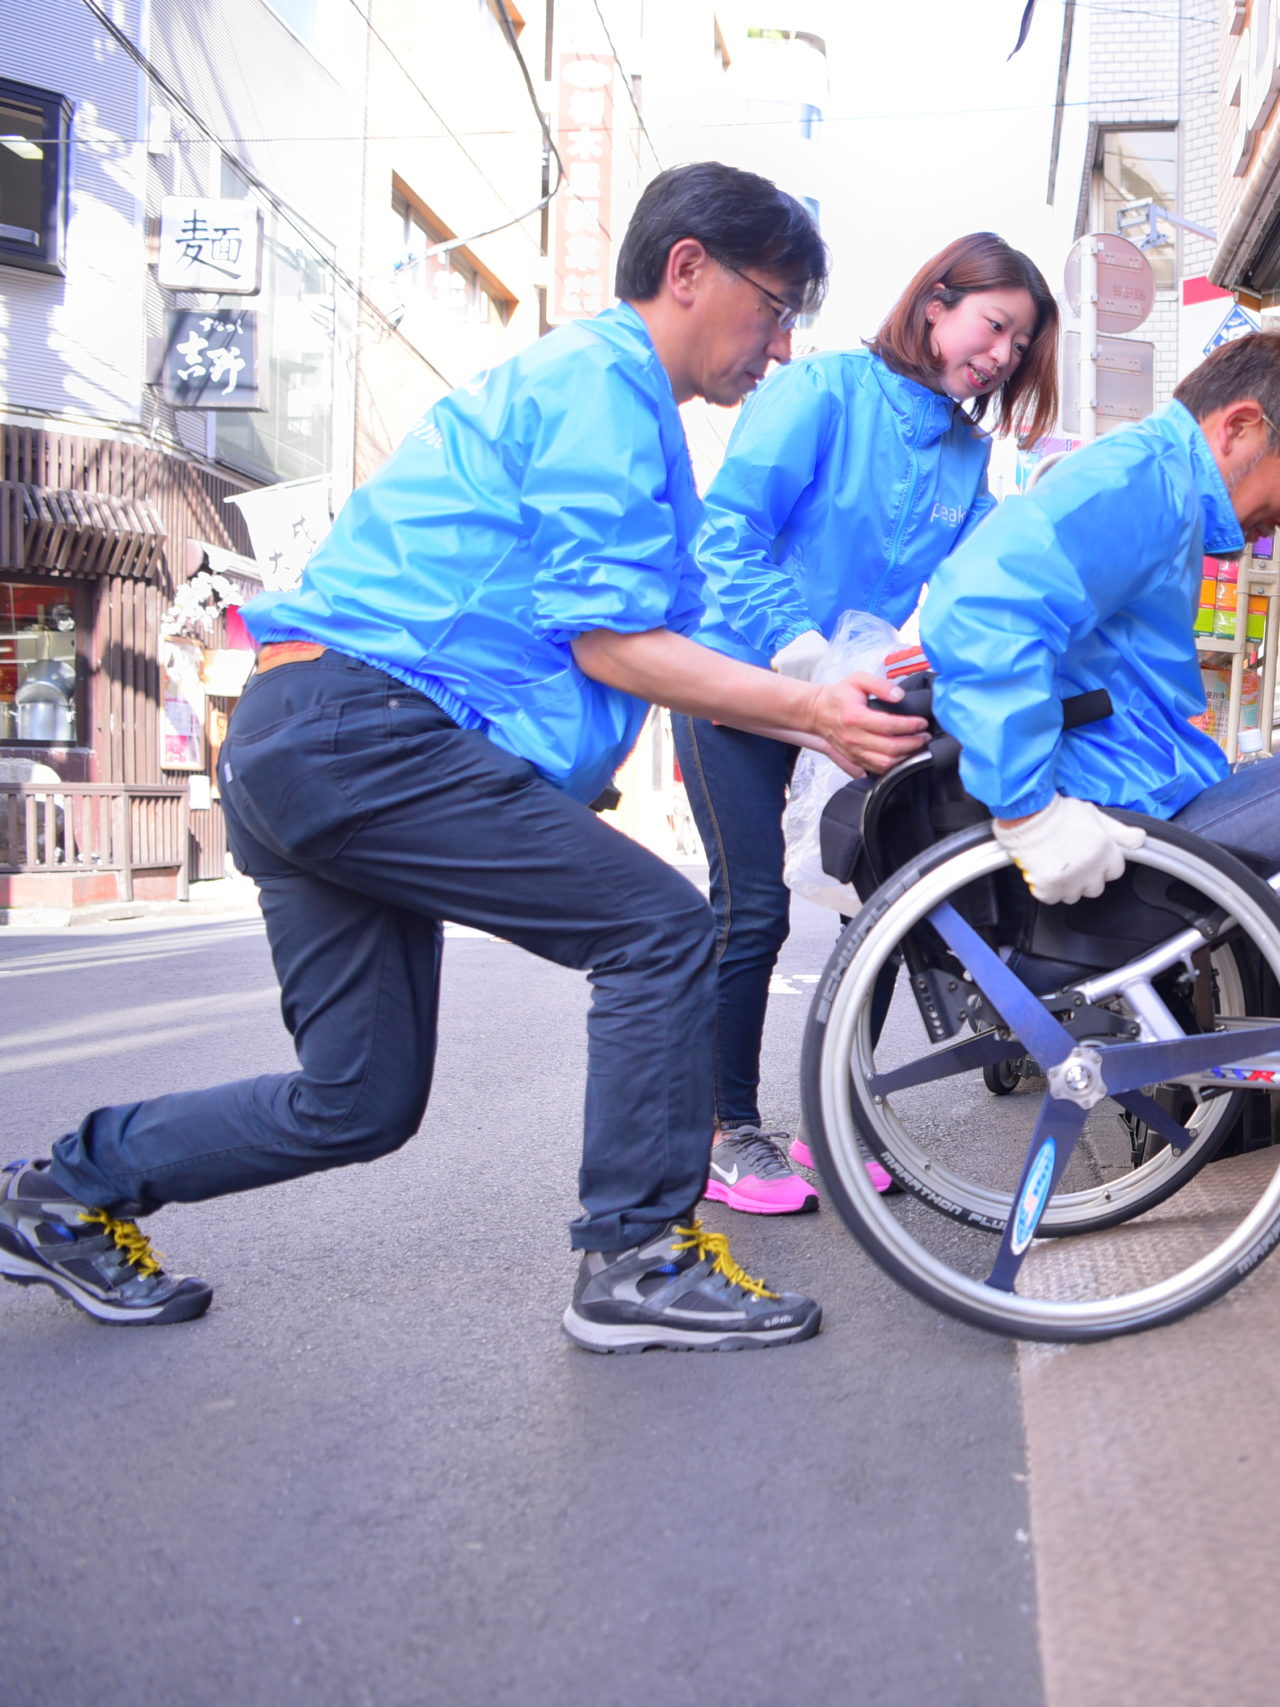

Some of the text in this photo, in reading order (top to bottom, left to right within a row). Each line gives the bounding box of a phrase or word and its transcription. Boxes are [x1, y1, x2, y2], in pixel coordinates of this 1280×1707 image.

[175, 209, 243, 279] 麺
[176, 331, 246, 395] 吉野
[880, 1151, 1007, 1232] MARATHON PLU
